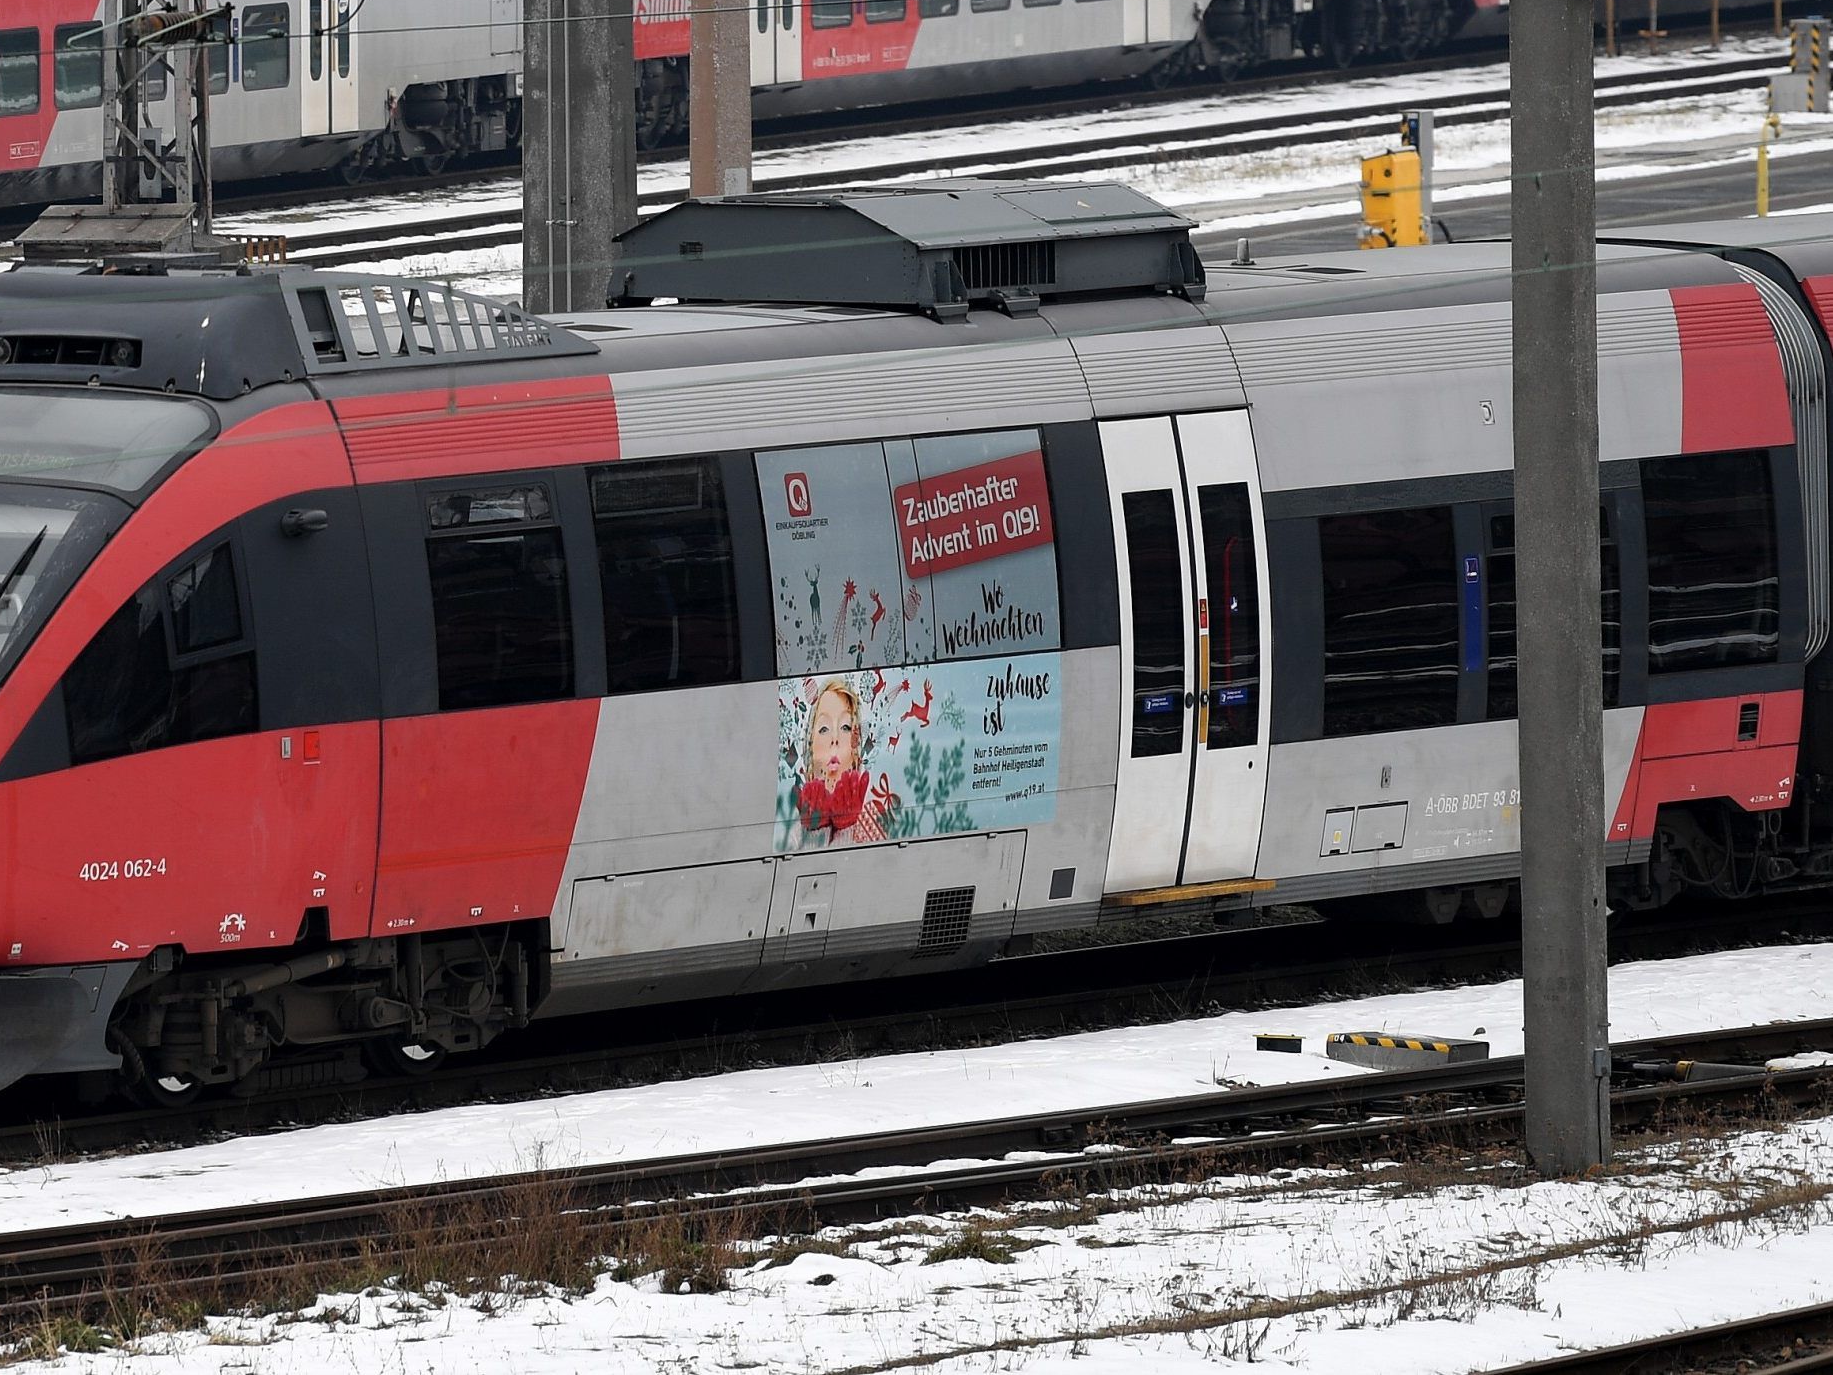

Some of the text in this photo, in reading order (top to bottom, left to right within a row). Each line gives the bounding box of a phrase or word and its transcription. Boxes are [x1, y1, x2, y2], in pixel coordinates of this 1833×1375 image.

[902, 475, 1019, 527] Zauberhafter
[911, 523, 973, 565] Advent
[975, 519, 998, 547] im
[981, 579, 1005, 615] Wo
[942, 605, 1044, 655] Weihnachten
[986, 663, 1052, 701] zuhause
[983, 700, 1007, 736] ist
[974, 742, 1048, 759] Nur 5 Gehminuten vom
[973, 756, 1045, 775] Bahnhof Heiligenstadt
[972, 776, 1002, 790] entfernt!
[1005, 782, 1045, 803] www.q19.at
[1425, 793, 1459, 817] A-ÖBB
[1462, 792, 1490, 810] BDET
[1493, 790, 1506, 807] 93
[79, 858, 167, 882] 4024 062-4
[220, 933, 241, 944] 500m
